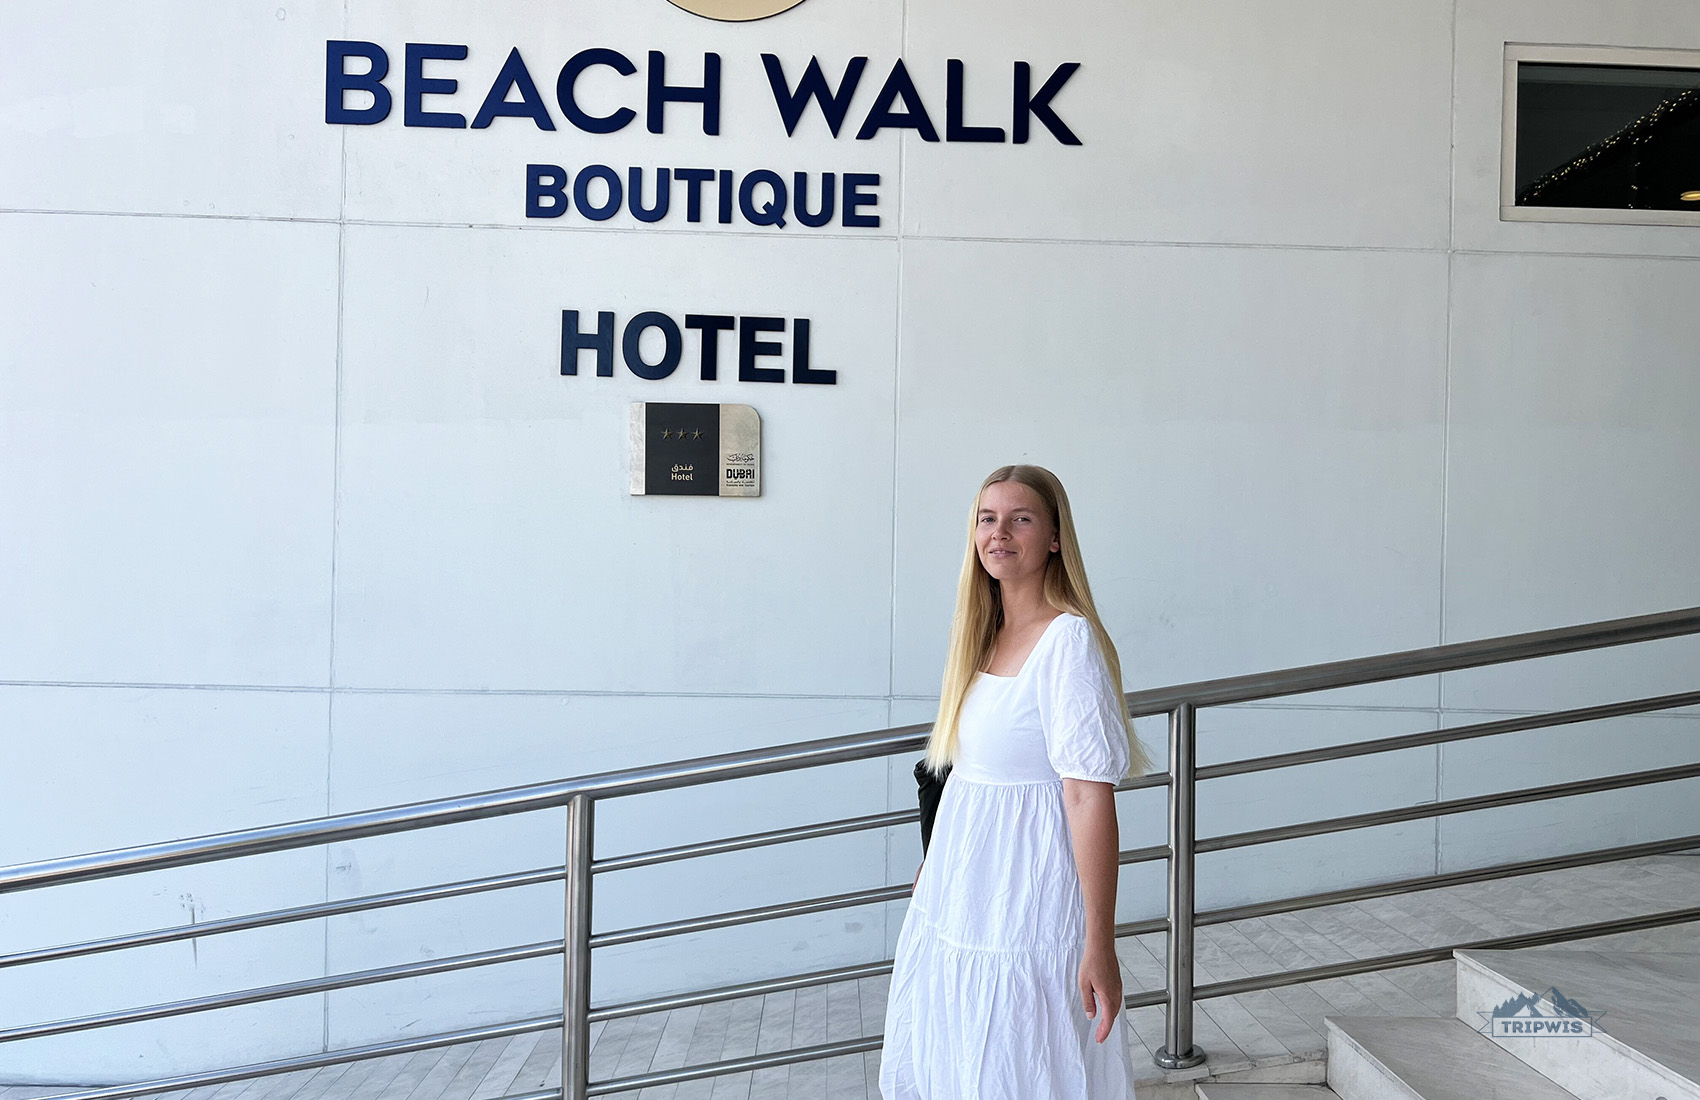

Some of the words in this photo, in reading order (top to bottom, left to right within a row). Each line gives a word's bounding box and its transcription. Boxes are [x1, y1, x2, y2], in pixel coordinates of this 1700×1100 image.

[325, 40, 721, 136] BEACH
[760, 53, 1083, 146] WALK
[525, 163, 881, 229] BOUTIQUE
[559, 309, 837, 386] HOTEL
[671, 463, 694, 473] فندق
[671, 472, 693, 481] Hotel
[726, 468, 755, 480] DUBAI
